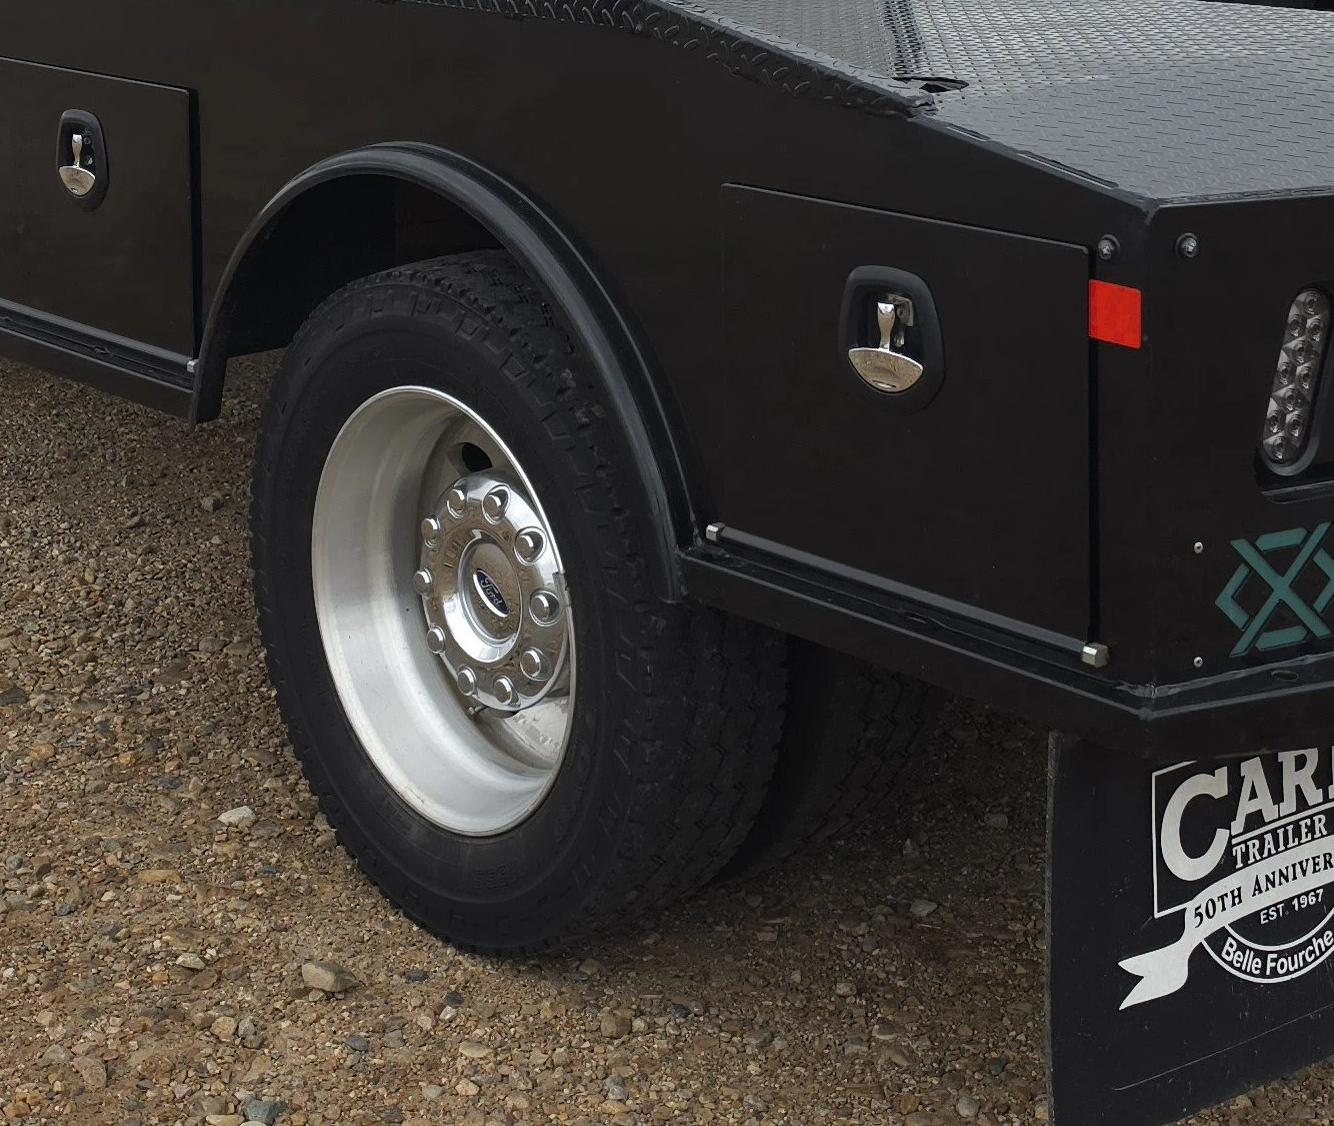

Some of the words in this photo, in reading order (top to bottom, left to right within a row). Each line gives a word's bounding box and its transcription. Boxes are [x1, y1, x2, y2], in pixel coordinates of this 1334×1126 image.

[480, 577, 503, 605] Ford
[1232, 814, 1328, 869] TRAILER
[1193, 886, 1244, 928] 50TH
[1260, 904, 1290, 925] EST.
[1291, 889, 1324, 912] 1967
[1221, 936, 1262, 975] Belle
